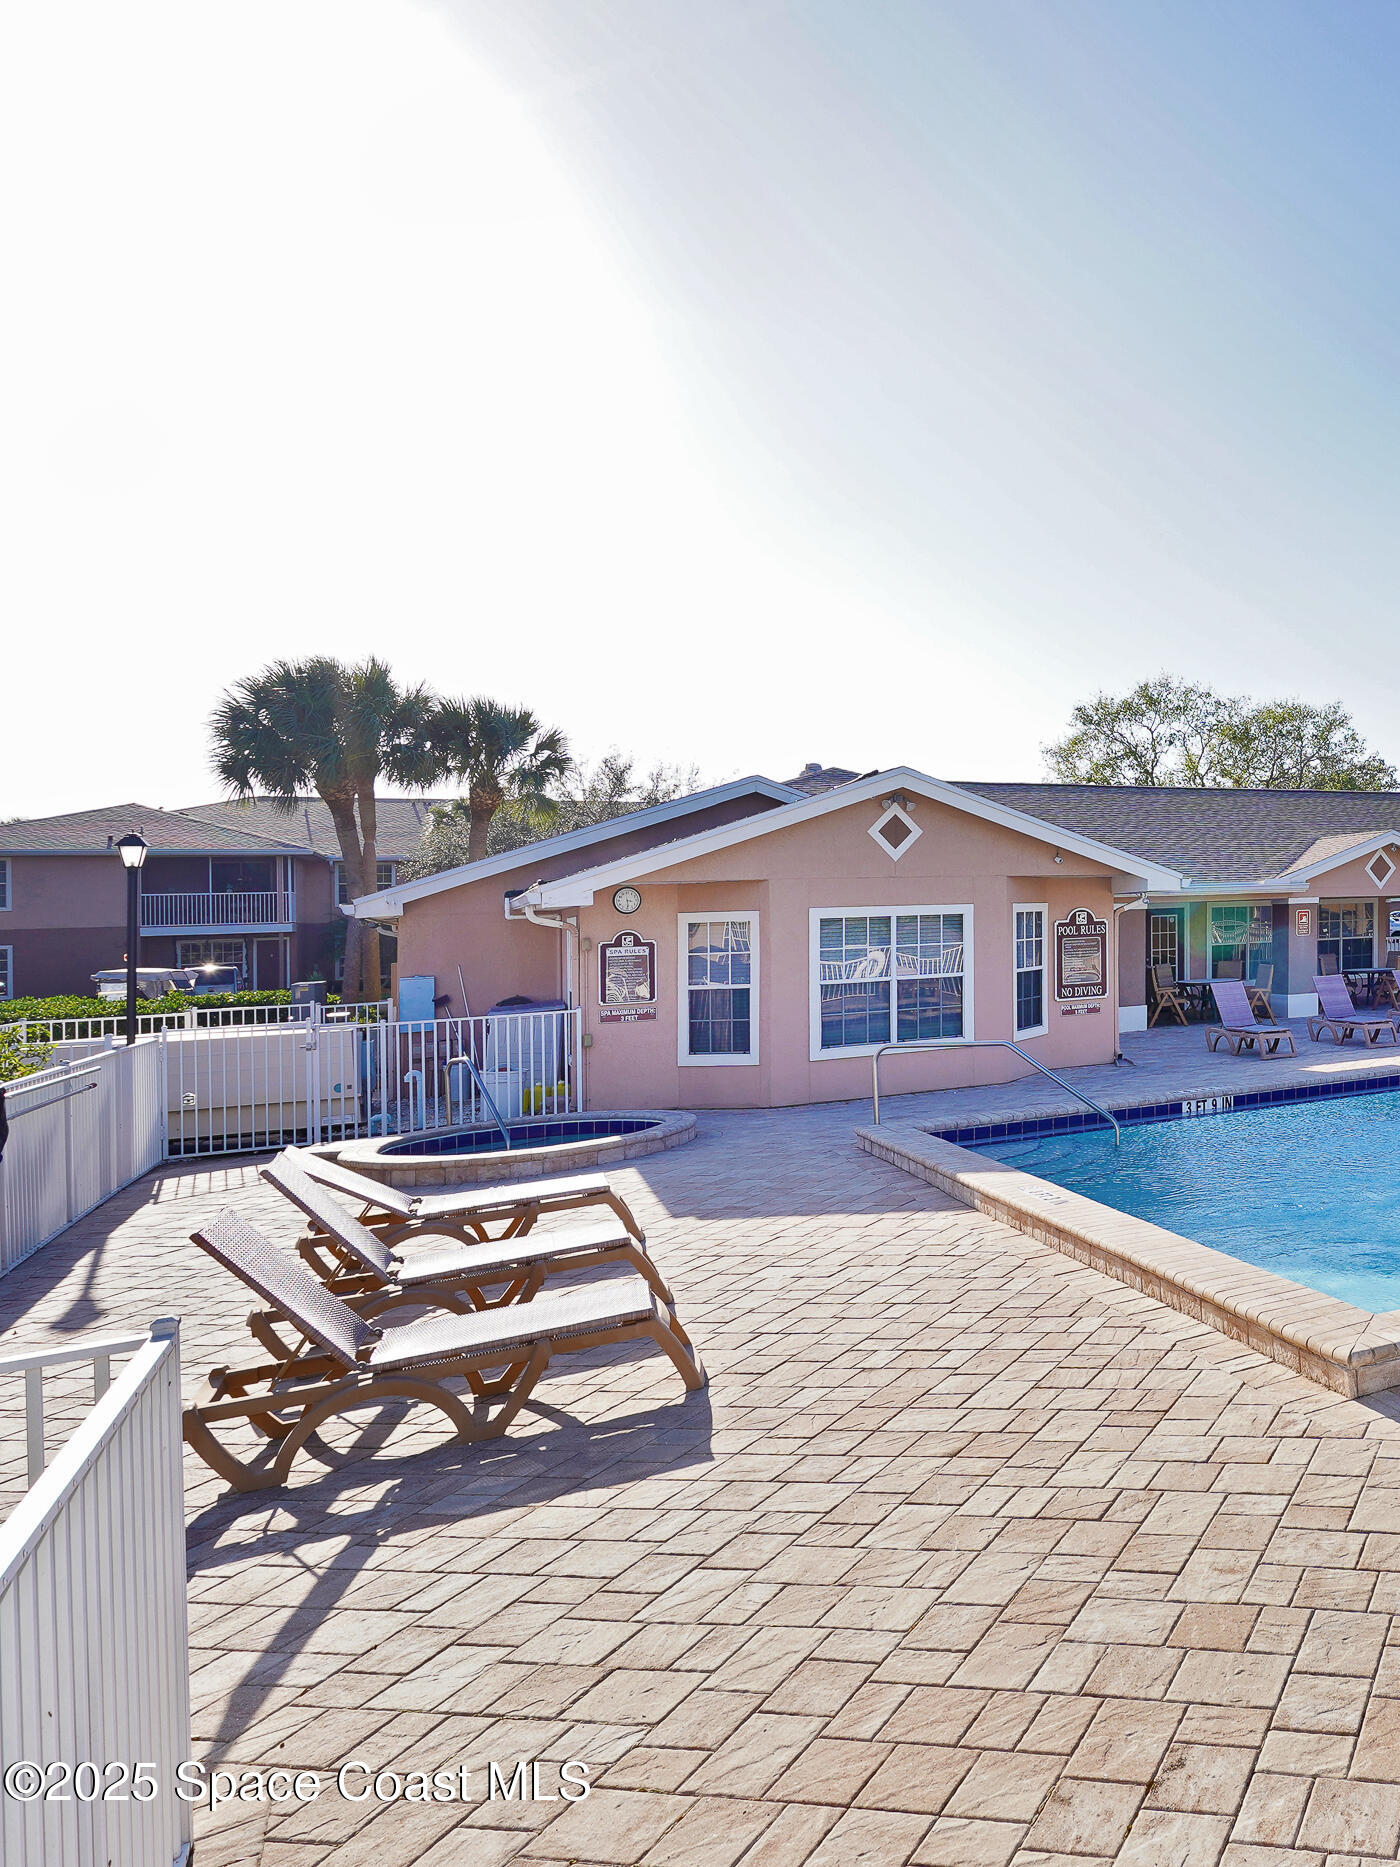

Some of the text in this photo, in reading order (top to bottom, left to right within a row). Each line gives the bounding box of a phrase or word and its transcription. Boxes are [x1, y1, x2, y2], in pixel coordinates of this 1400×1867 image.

[1058, 924, 1106, 936] POOL RULES
[1061, 985, 1102, 997] NO DIVING
[611, 1008, 635, 1016] MAXIMUM
[1186, 1096, 1232, 1114] 3 FT 9 IN
